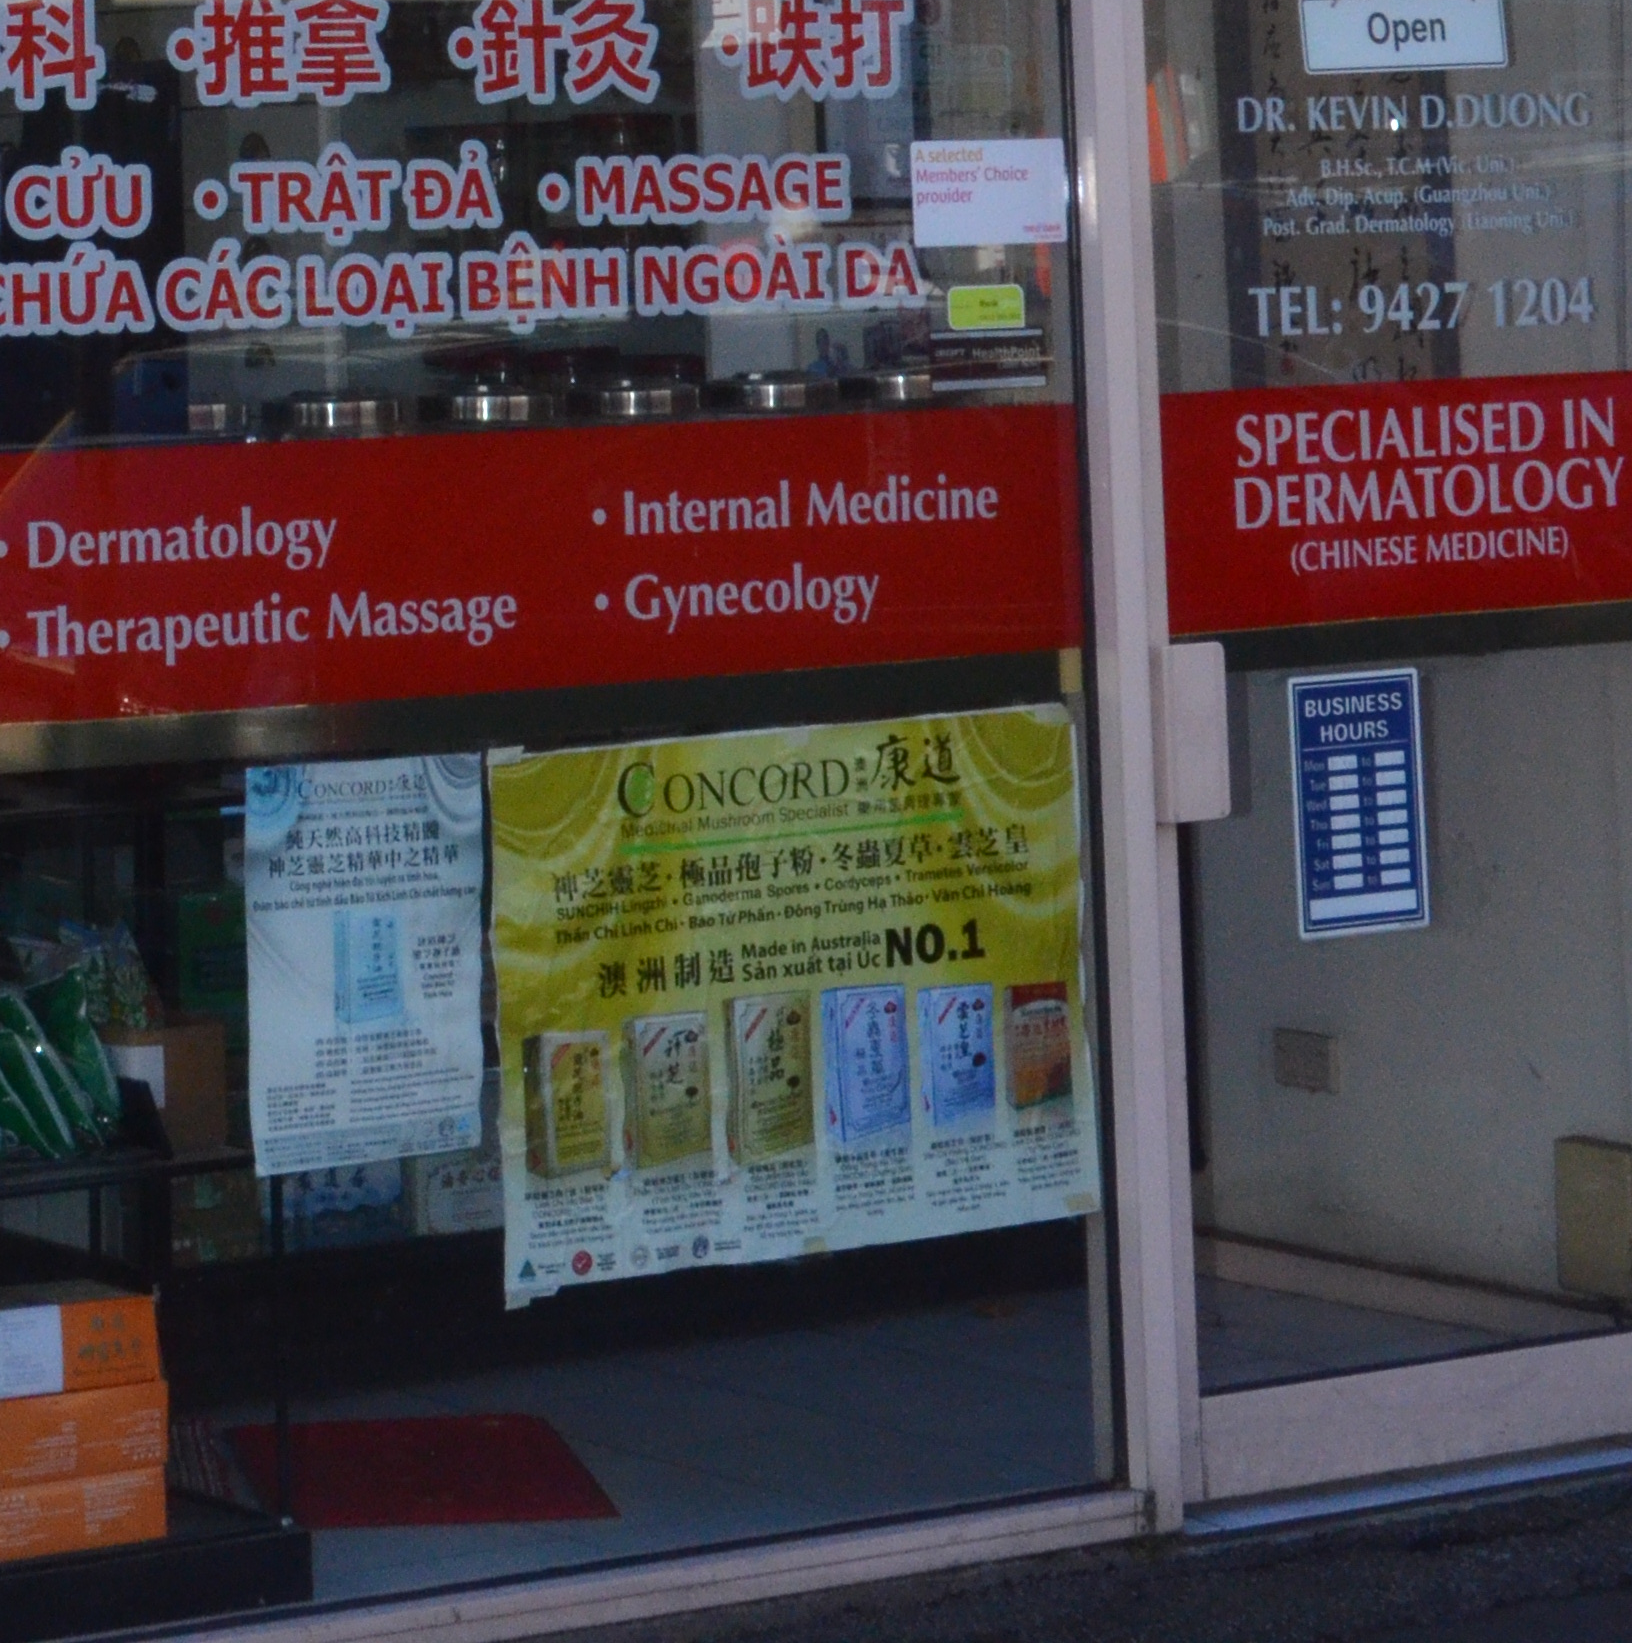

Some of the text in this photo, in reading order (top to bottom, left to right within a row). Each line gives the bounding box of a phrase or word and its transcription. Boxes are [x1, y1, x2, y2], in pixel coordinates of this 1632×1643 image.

[1366, 11, 1447, 51] Open
[1237, 96, 1295, 133] DR.
[1307, 94, 1408, 132] KEVIN
[928, 147, 983, 163] selected
[984, 167, 1029, 182] Choice
[13, 154, 146, 231] CỬU
[238, 151, 394, 238] TRẬT
[410, 148, 494, 220] ĐẢ
[583, 159, 844, 216] MASSAGE
[1305, 216, 1350, 235] Grad.
[1354, 215, 1454, 238] Dermatology
[165, 247, 283, 322] CÁC
[306, 260, 445, 329] LOẠI
[470, 241, 622, 327] BỆNH
[642, 243, 824, 307] NGOÀI
[845, 246, 919, 300] DA
[1248, 275, 1594, 337] TEL: 9427 1204
[1235, 396, 1616, 469] SPECIALISED IN
[623, 473, 1000, 537] Internal Medicine
[1233, 456, 1625, 531] DERMATOLOGY
[26, 504, 339, 573] Dermatology
[1290, 525, 1570, 576] (CHINESE MEDICINE)
[624, 565, 880, 633] Gynecology
[27, 587, 518, 667] Therapeutic Massage
[1304, 692, 1403, 718] BUSINESS
[1320, 720, 1389, 743] HOURS
[617, 759, 850, 818] CONCORD
[697, 812, 775, 831] Mushroom
[779, 803, 849, 823] Specialist
[683, 888, 762, 908] Ganoderma
[767, 881, 809, 901] Spores
[824, 873, 892, 893] Cordyceps
[741, 930, 882, 961] Made in Australia
[884, 918, 986, 969] NO.1
